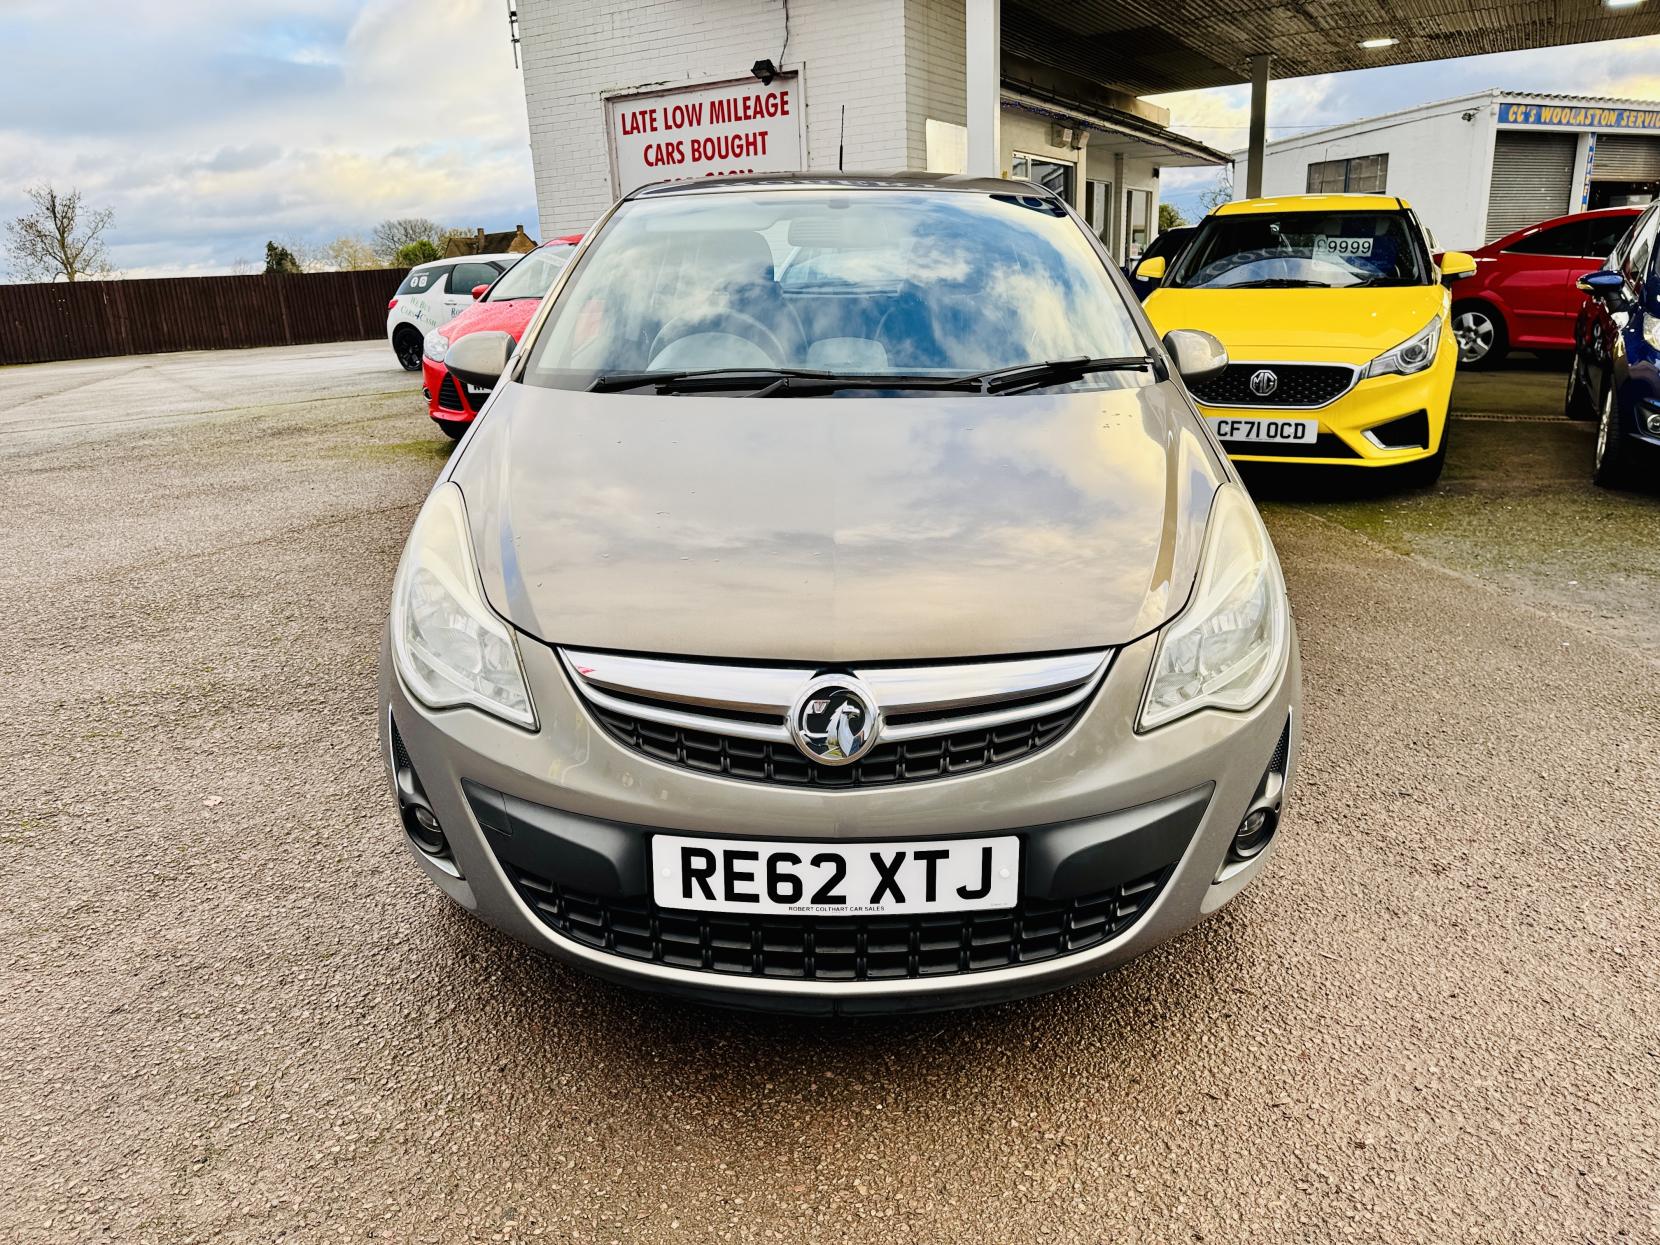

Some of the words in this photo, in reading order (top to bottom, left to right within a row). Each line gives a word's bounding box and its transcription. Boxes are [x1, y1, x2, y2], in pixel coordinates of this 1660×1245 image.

[621, 108, 658, 136] LATE
[663, 102, 703, 130] LOW
[709, 90, 790, 125] MILEAGE
[643, 140, 686, 167] CARS
[690, 130, 769, 162] BOUGHT
[1252, 372, 1275, 394] MG
[1217, 420, 1261, 438] CF71
[1266, 421, 1306, 440] OCD
[680, 846, 847, 905] RE62
[869, 846, 993, 905] XTJ
